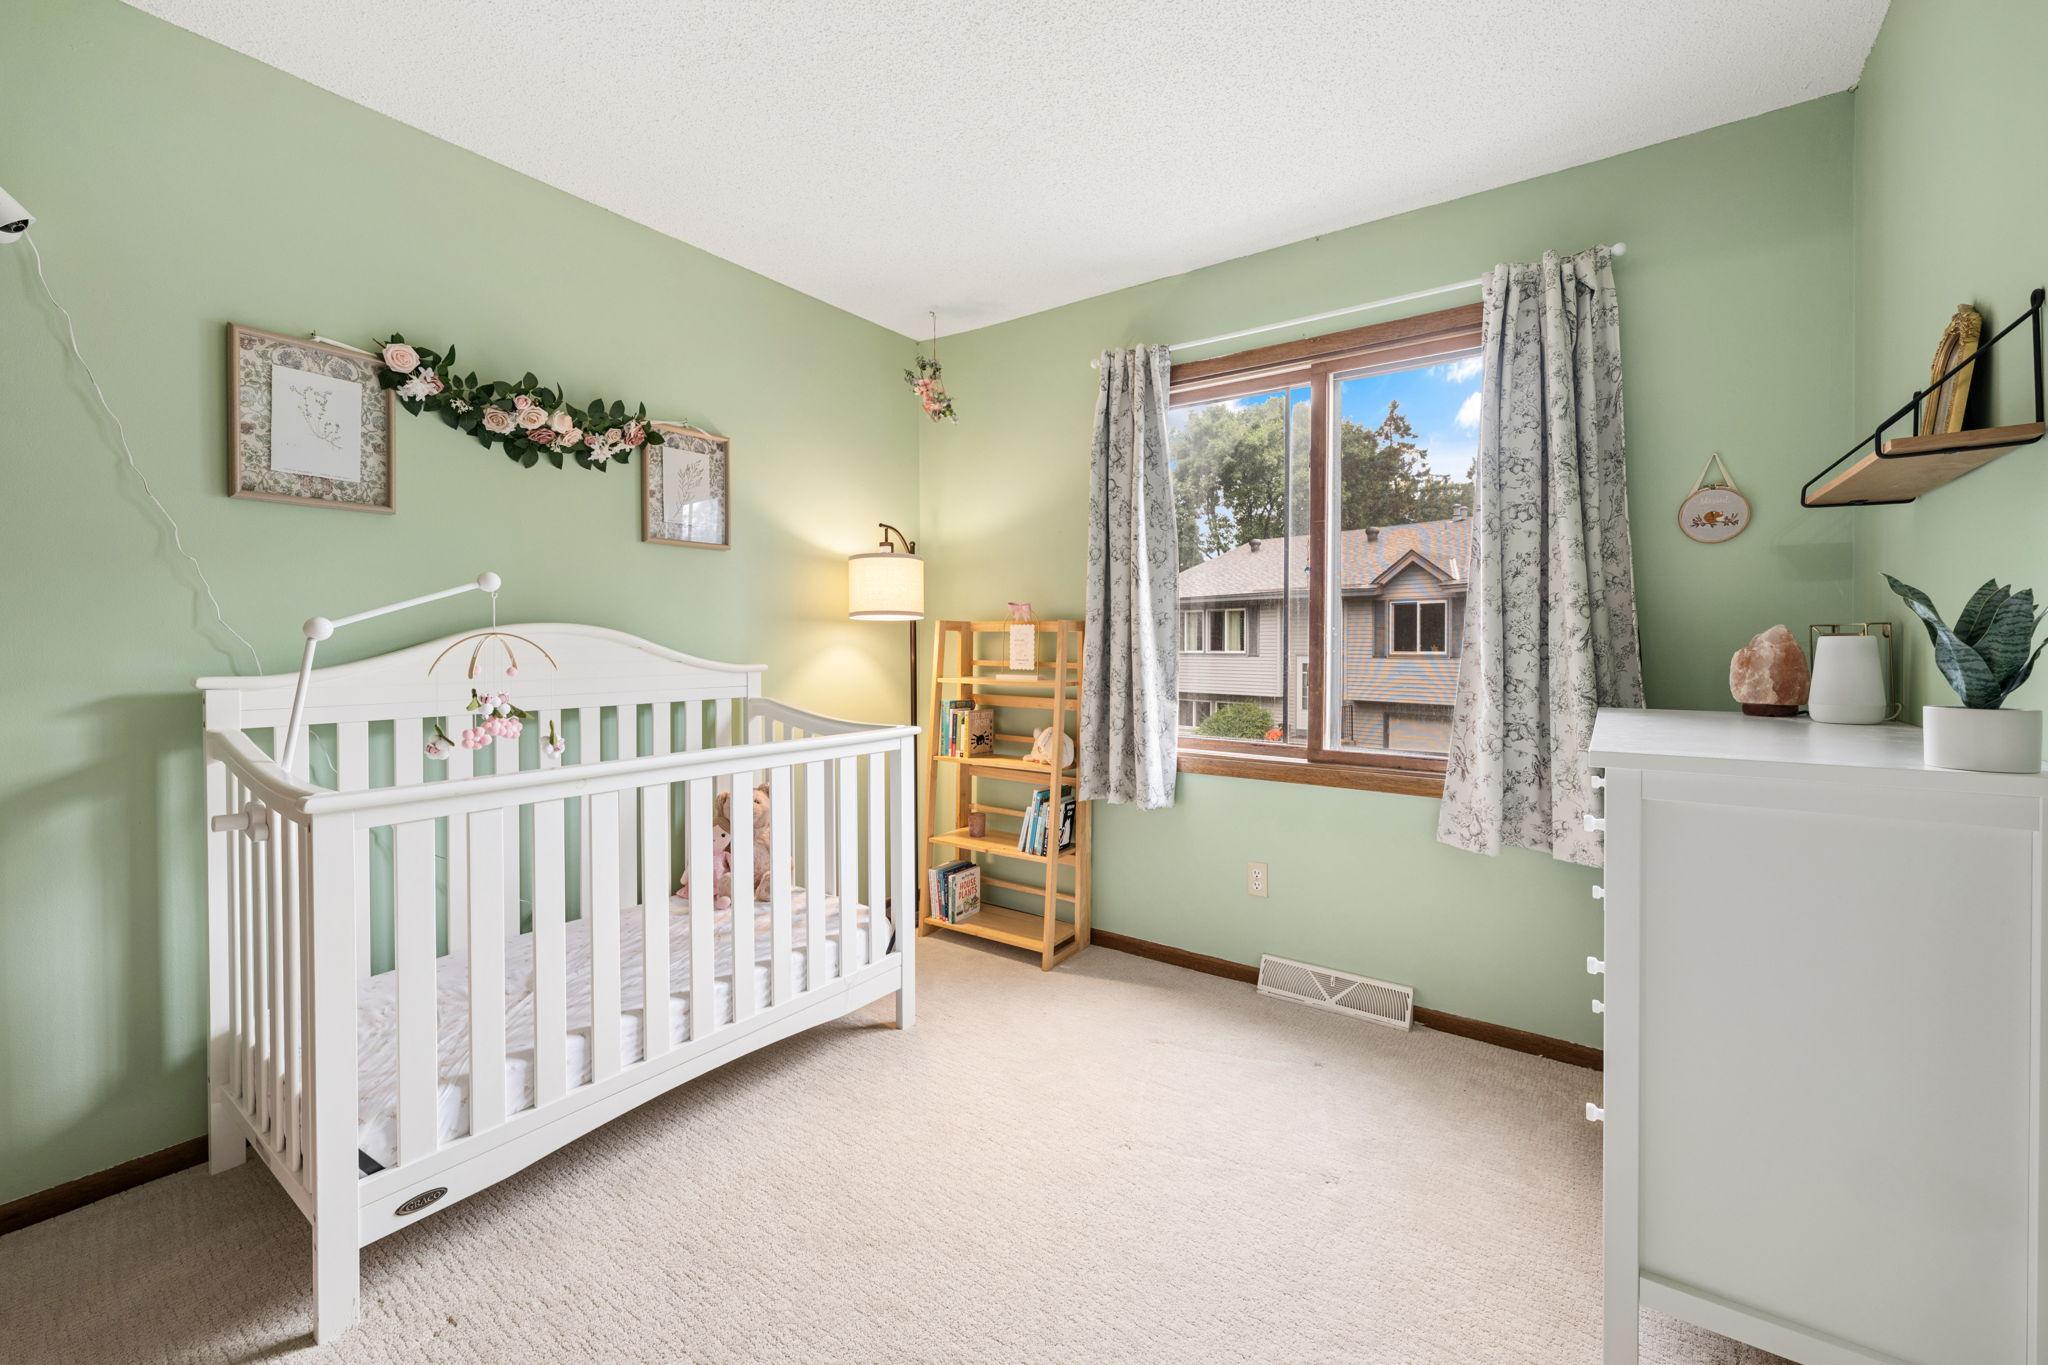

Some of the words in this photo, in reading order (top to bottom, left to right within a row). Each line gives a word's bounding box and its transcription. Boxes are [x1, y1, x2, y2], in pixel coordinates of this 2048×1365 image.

[959, 876, 977, 891] HOUSE
[958, 885, 977, 900] PLANTS
[405, 1191, 442, 1212] GRACO
